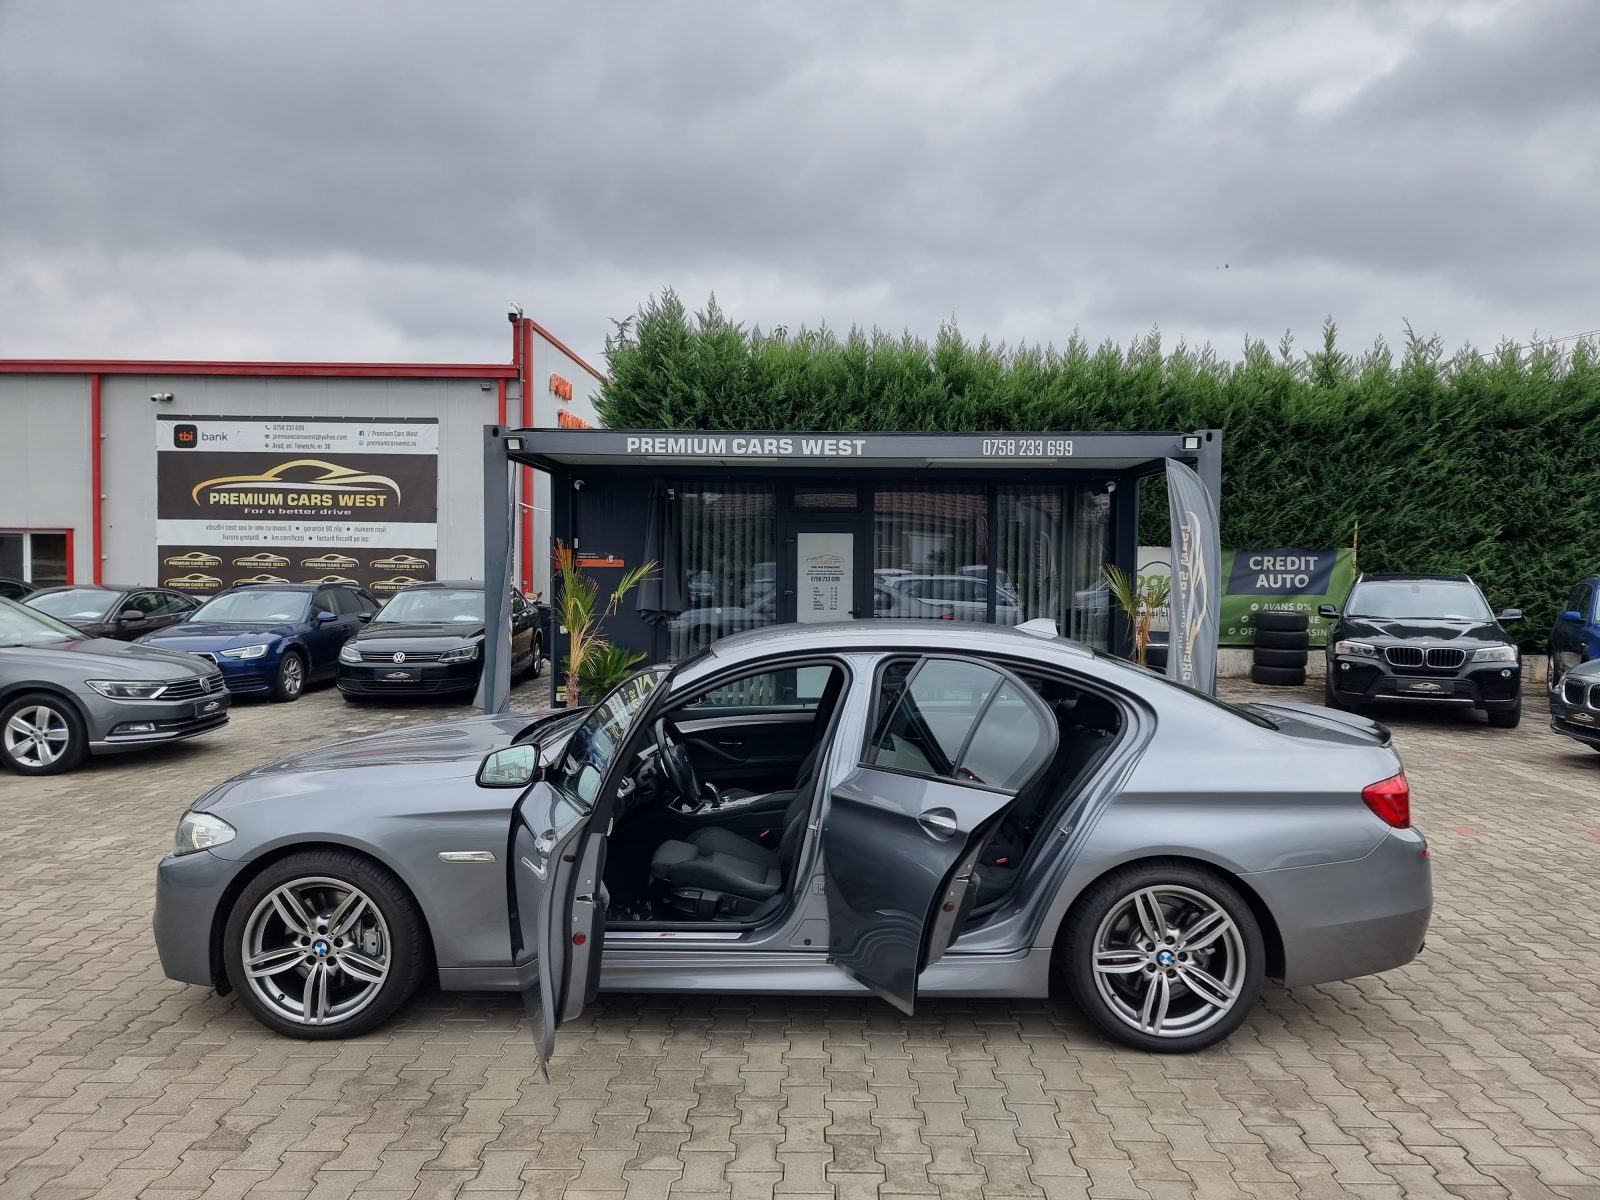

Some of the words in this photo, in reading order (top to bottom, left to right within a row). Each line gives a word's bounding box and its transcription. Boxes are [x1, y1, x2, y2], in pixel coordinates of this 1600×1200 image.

[178, 431, 194, 441] tbi
[201, 432, 228, 441] bank
[627, 437, 726, 454] PREMIUM
[732, 438, 793, 455] CARS
[801, 439, 866, 455] WEST
[983, 440, 1015, 456] 0758
[1019, 440, 1043, 456] 233
[1047, 440, 1073, 456] 699
[209, 493, 284, 506] PREMIUM
[287, 493, 333, 507] CARS
[338, 494, 388, 507] WEST
[1249, 556, 1319, 571] CREDIT
[1256, 573, 1310, 588] AUTO
[1262, 602, 1295, 611] AVANS
[1297, 602, 1312, 611] 0%
